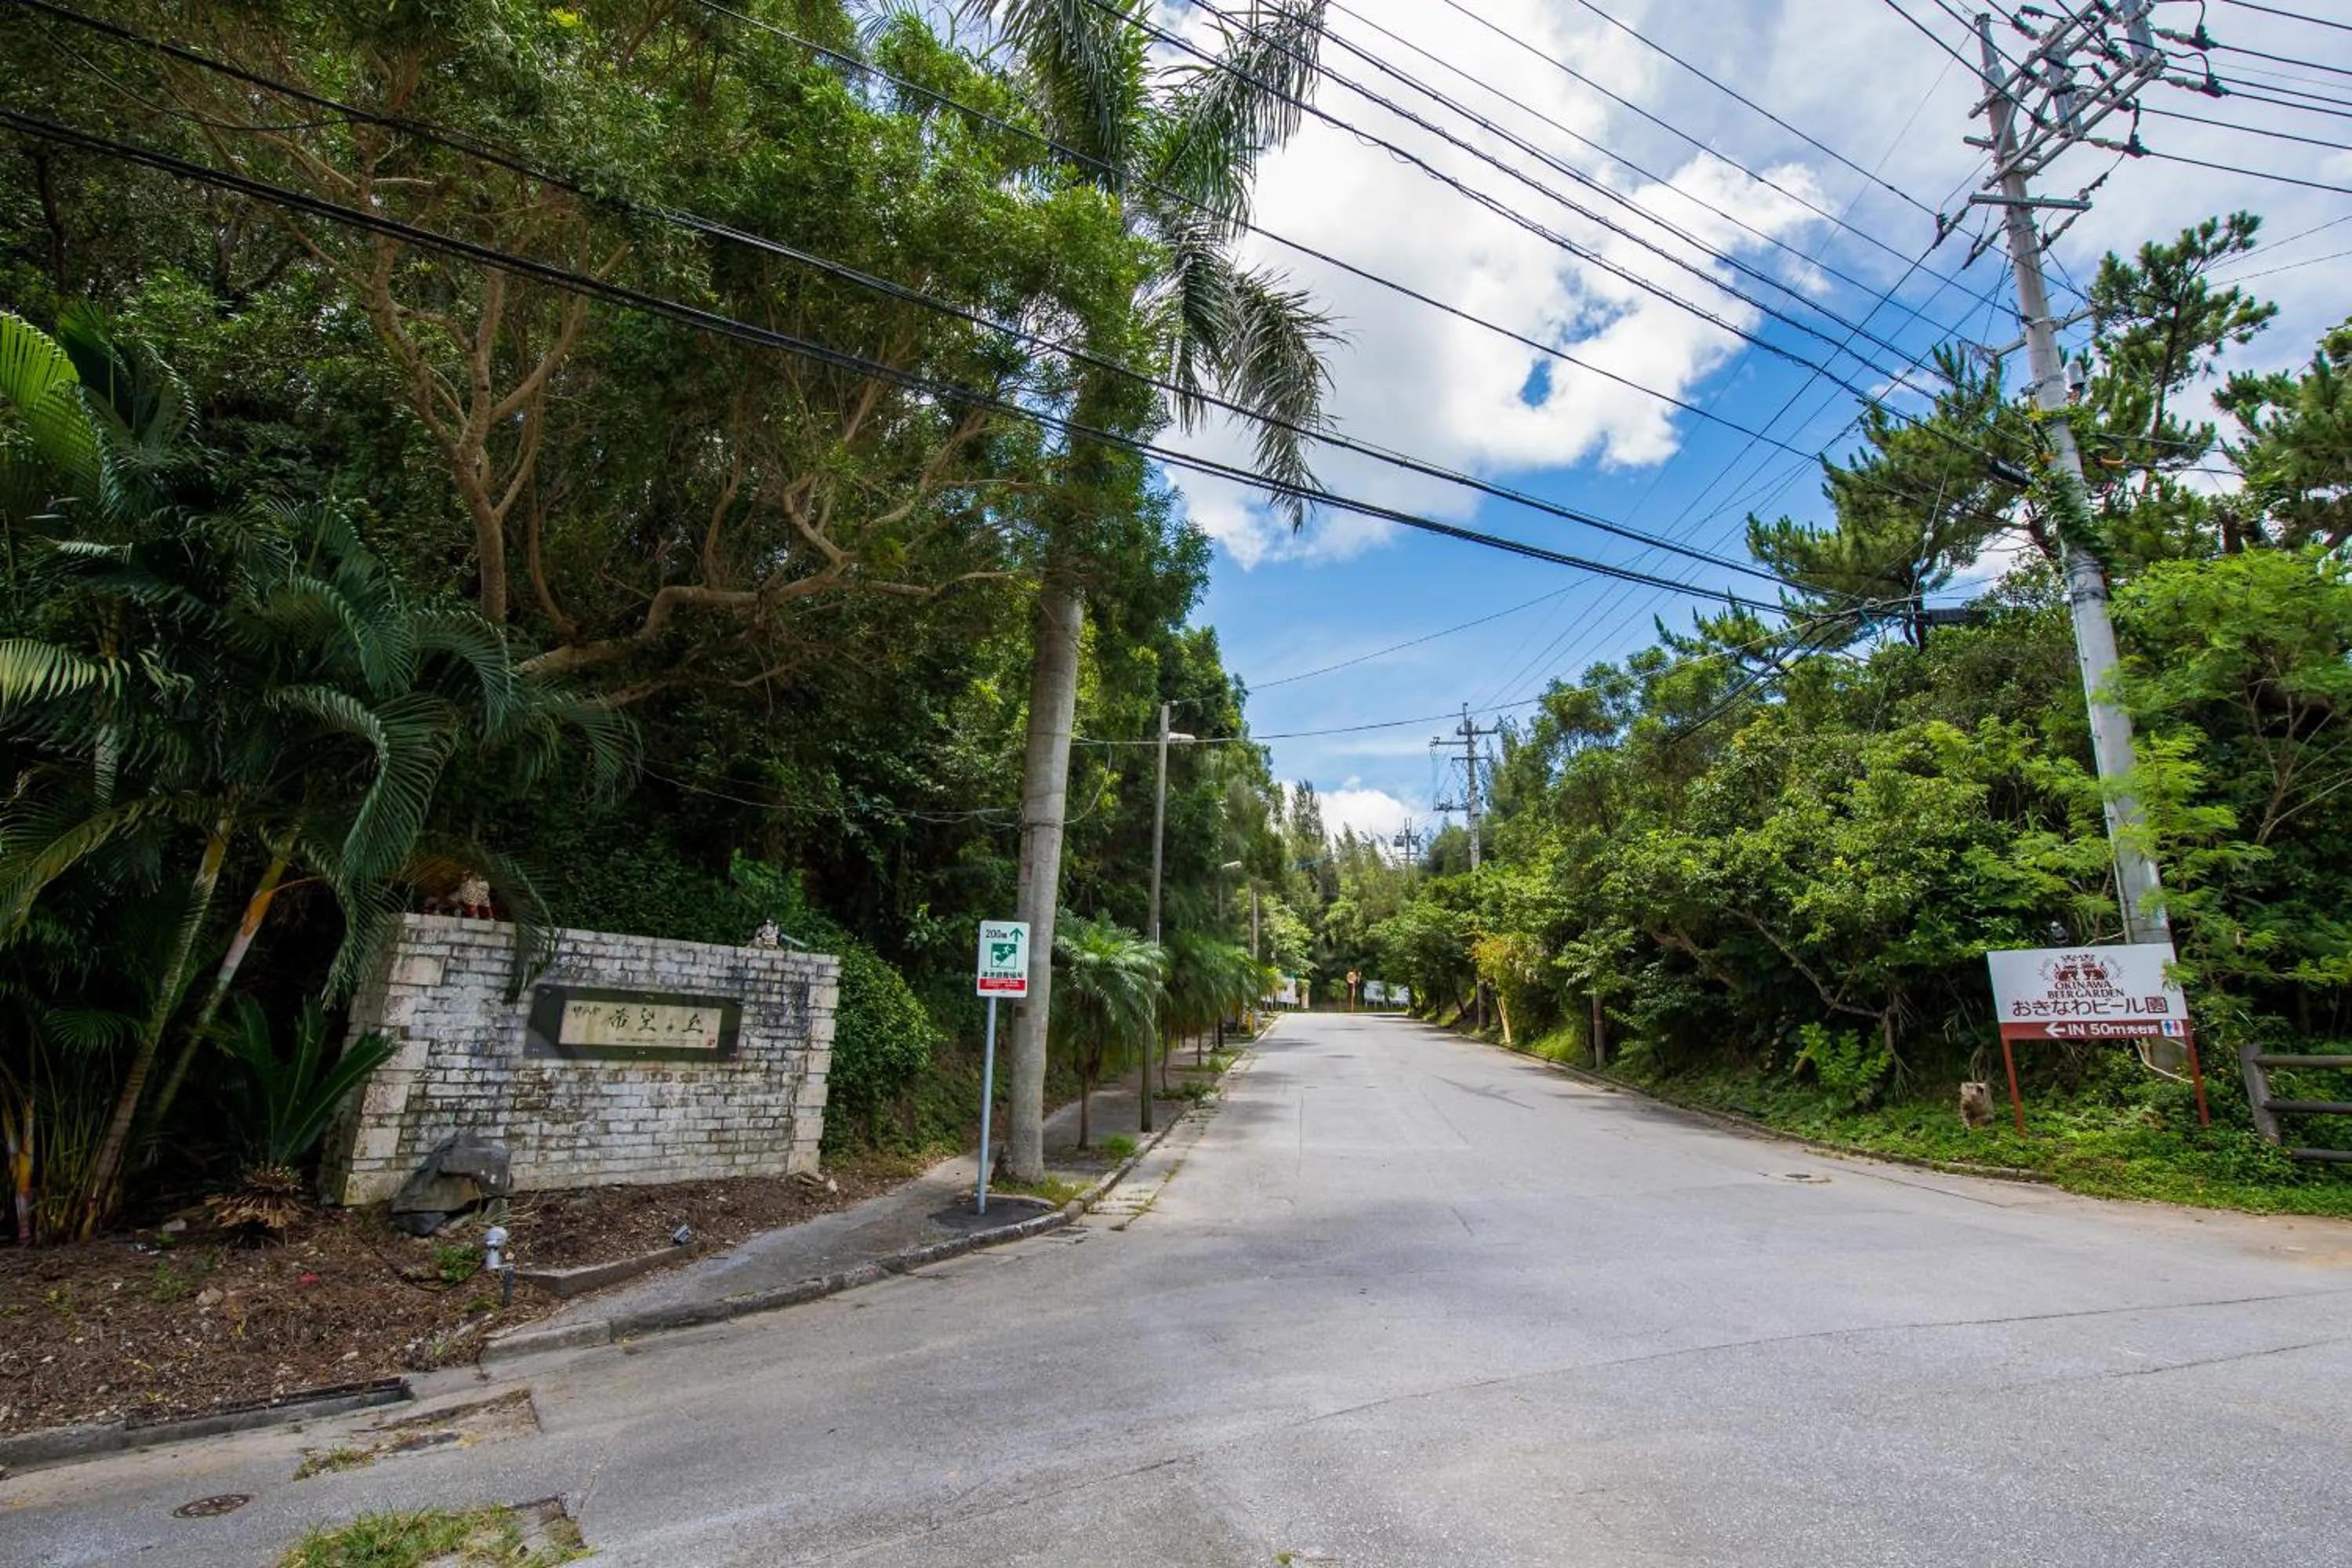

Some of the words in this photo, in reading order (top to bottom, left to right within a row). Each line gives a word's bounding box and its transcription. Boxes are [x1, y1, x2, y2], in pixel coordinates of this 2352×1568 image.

[2055, 981, 2112, 989] OKINAWA
[2048, 990, 2074, 999] BEER
[2075, 989, 2125, 998] GARDEN
[2012, 996, 2169, 1017] おきなわビール園
[2067, 1023, 2085, 1036] IN
